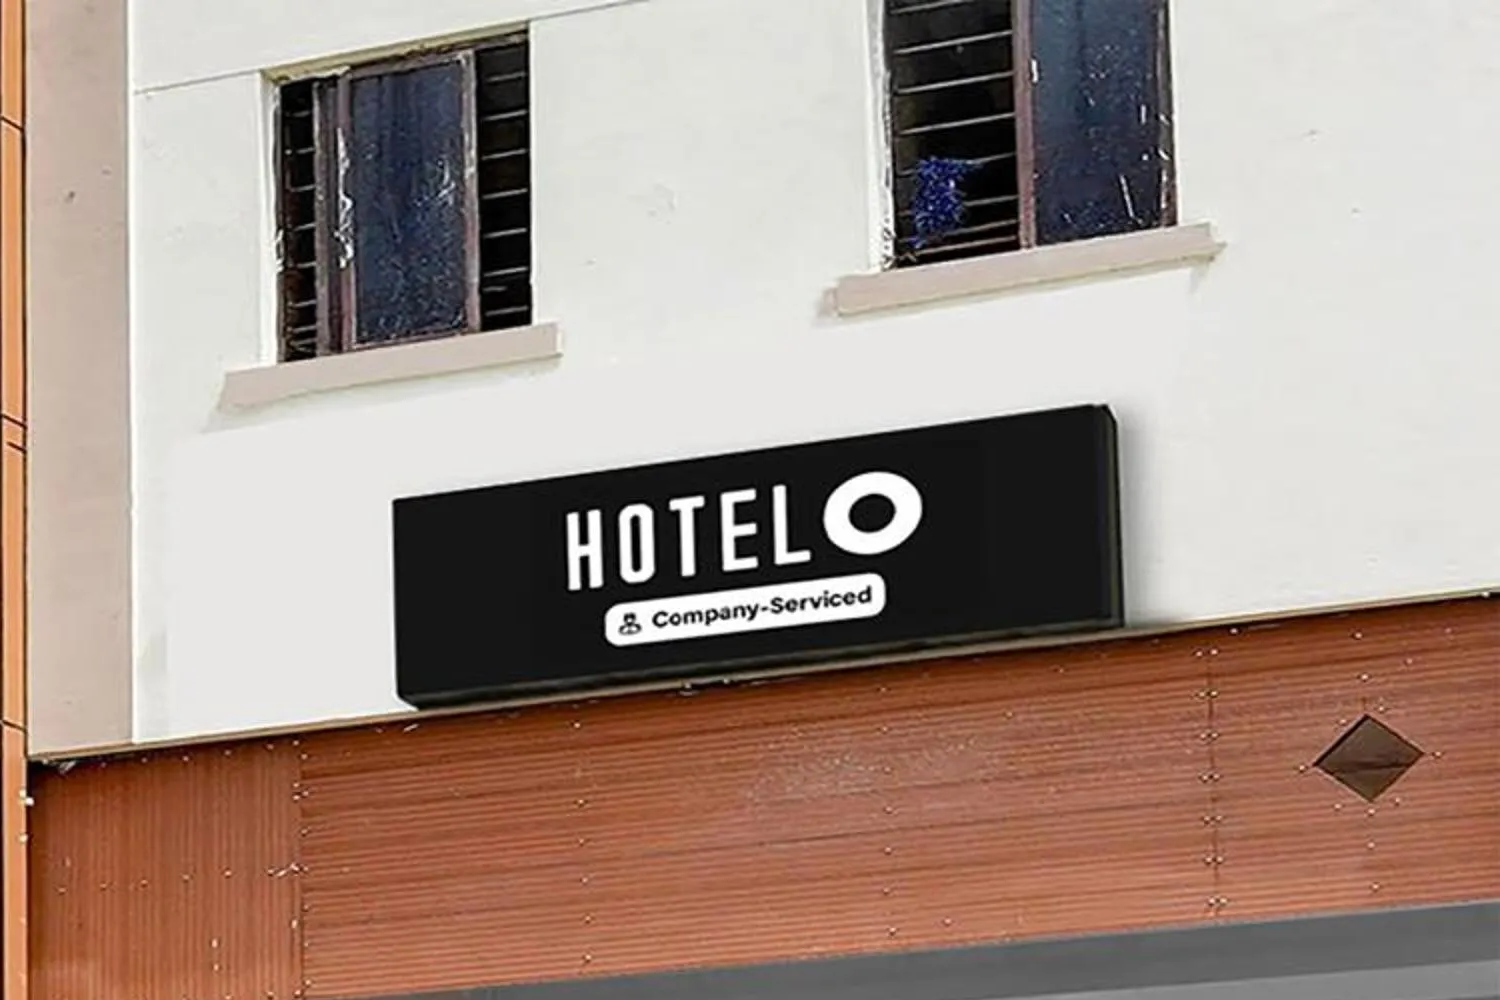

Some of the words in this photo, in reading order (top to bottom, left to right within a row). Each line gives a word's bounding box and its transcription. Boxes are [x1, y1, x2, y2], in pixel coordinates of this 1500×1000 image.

[566, 485, 811, 590] HOTEL
[823, 471, 923, 555] O
[651, 585, 873, 628] Company-Serviced
